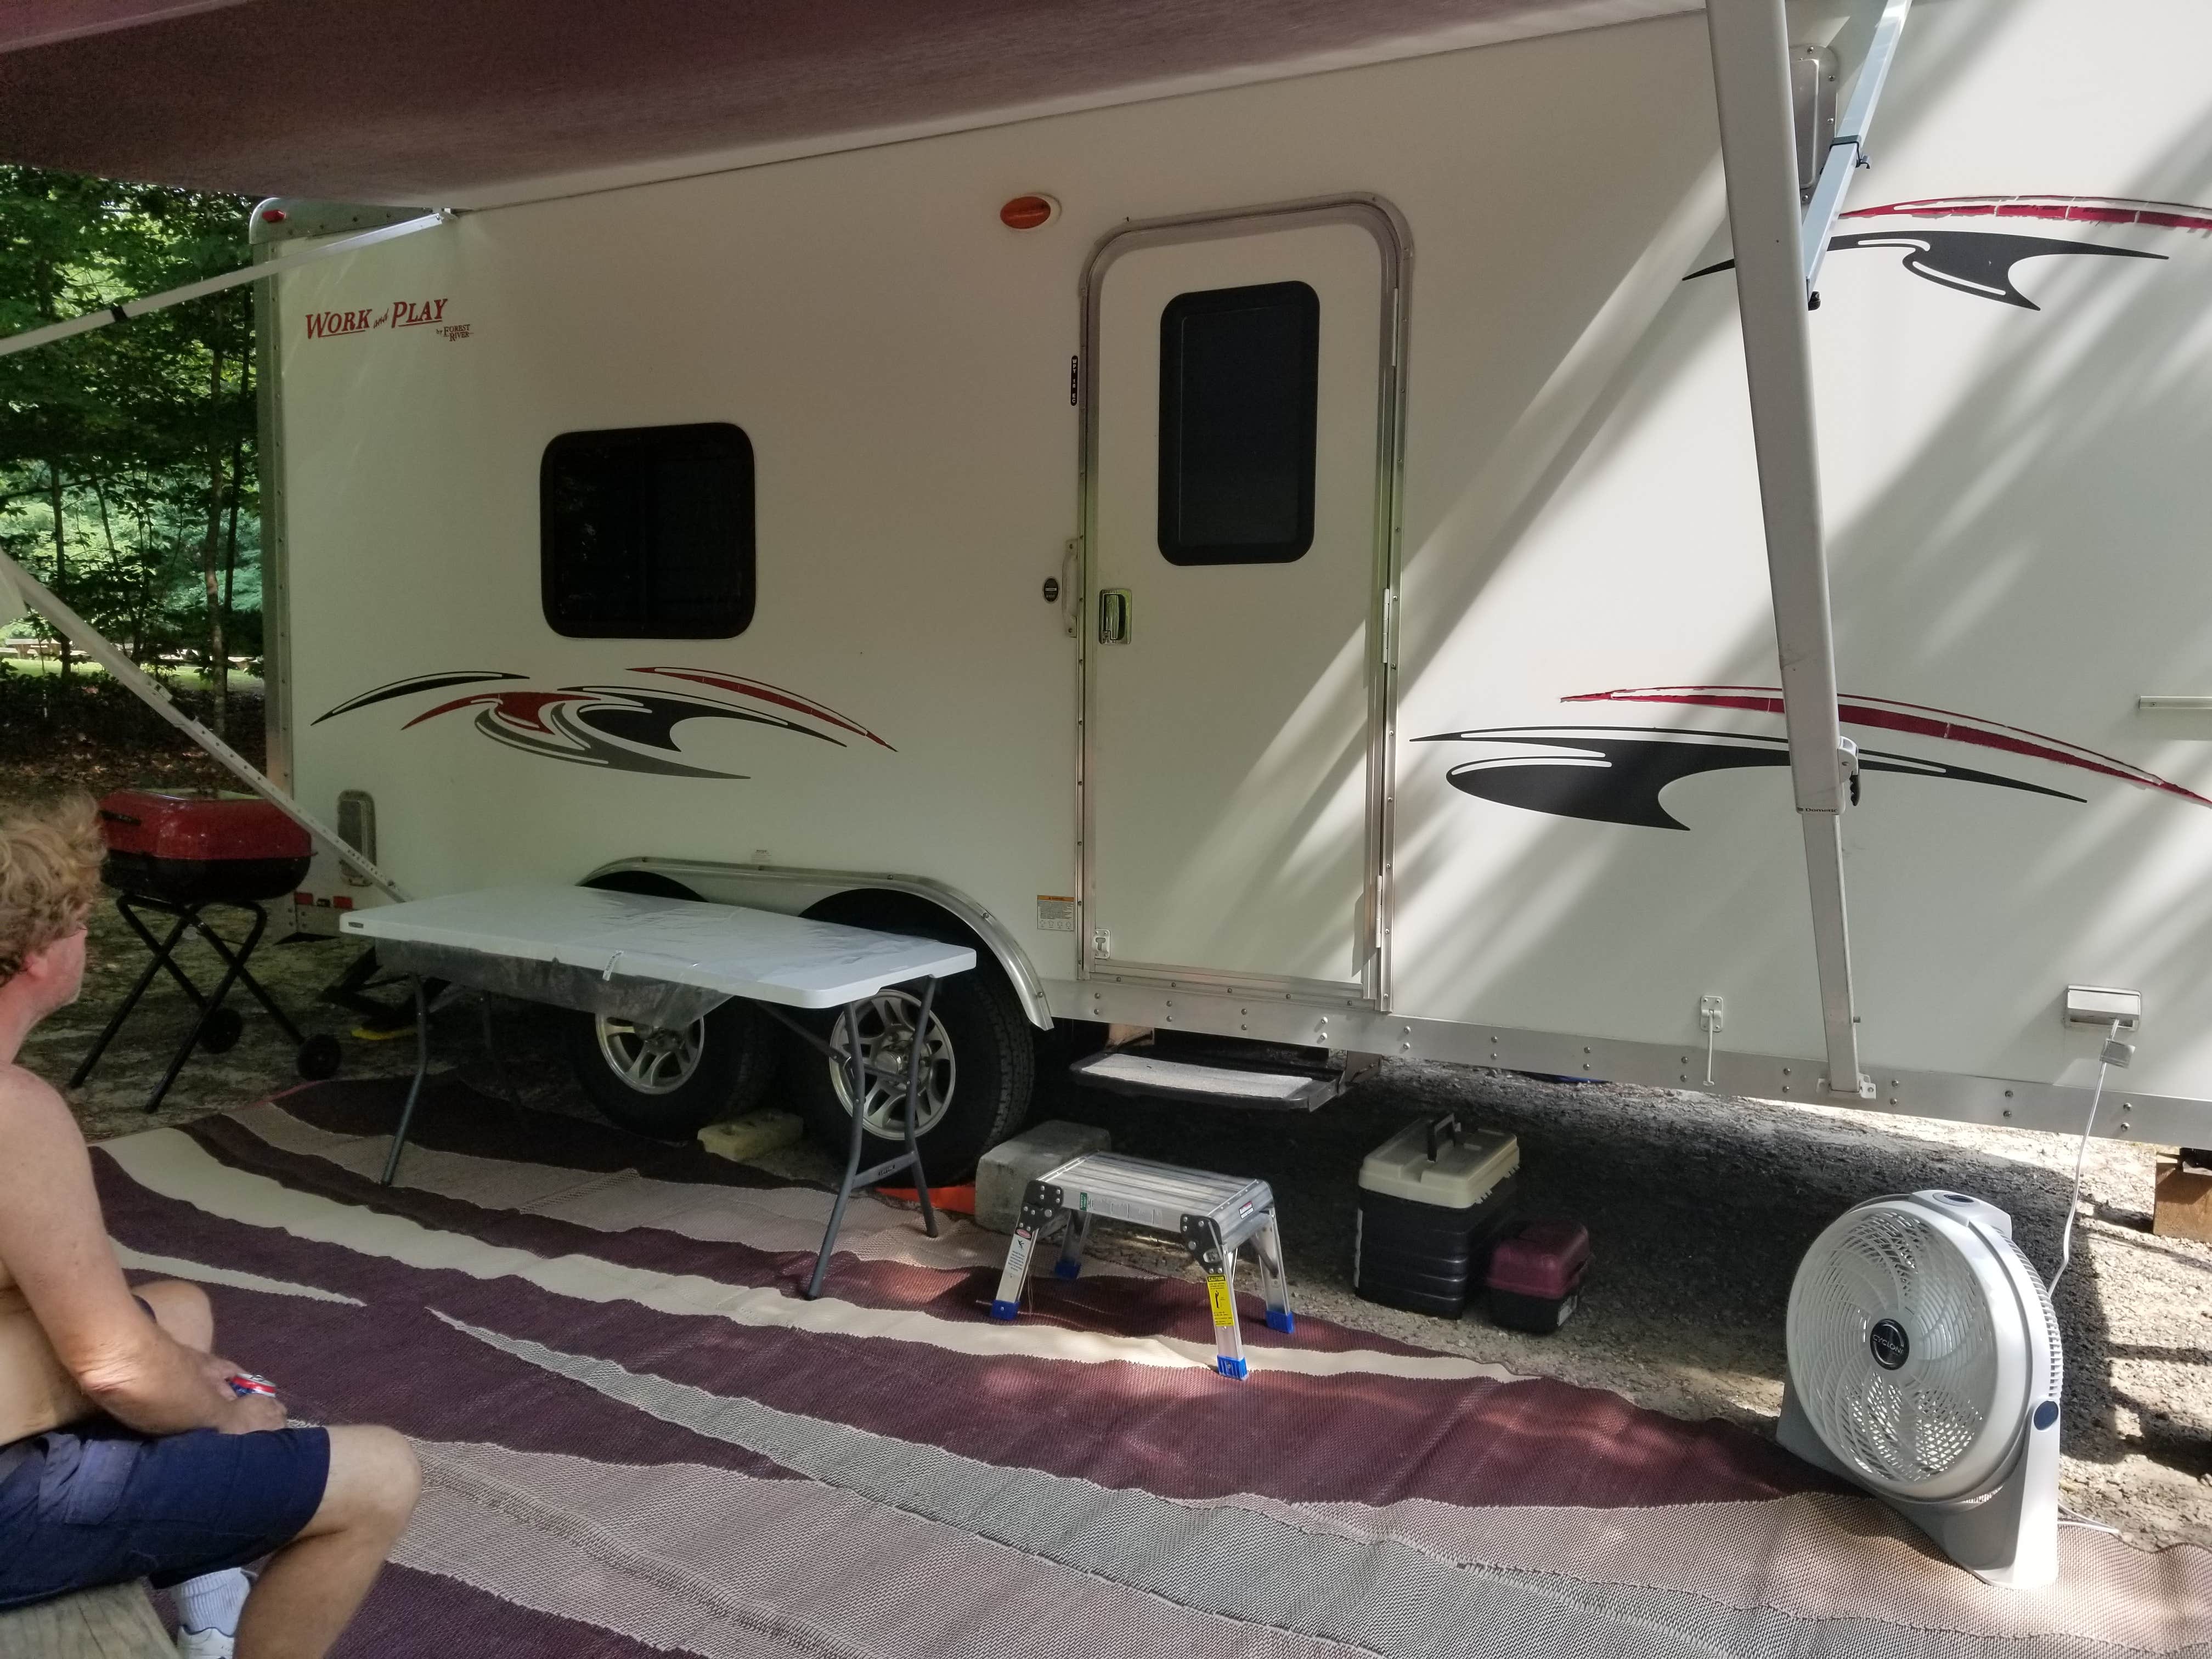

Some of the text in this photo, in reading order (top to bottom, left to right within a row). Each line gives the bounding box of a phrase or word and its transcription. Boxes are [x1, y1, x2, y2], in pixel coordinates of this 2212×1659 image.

[305, 298, 448, 339] WORK and PLAY
[443, 324, 470, 336] FOREST
[449, 331, 470, 342] RIVER
